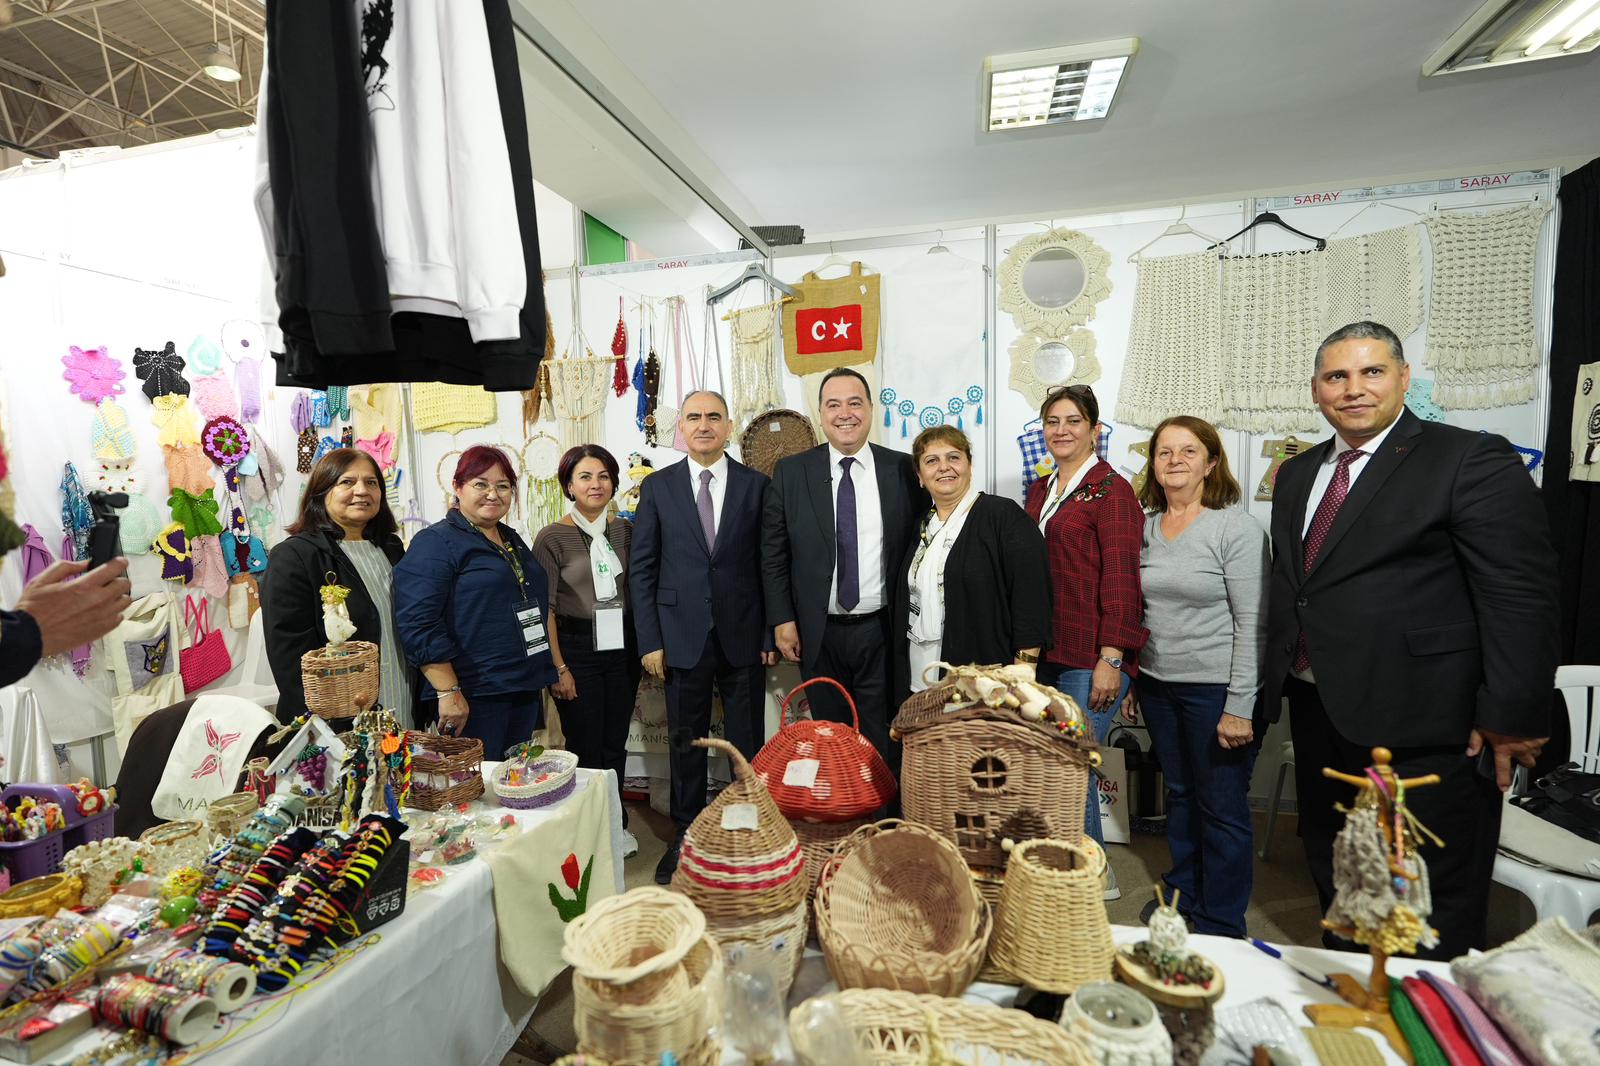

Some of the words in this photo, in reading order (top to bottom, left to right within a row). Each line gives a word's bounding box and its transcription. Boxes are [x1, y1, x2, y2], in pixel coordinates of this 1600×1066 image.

[1460, 174, 1511, 189] SARAY
[1294, 191, 1341, 205] SARAY
[657, 260, 689, 270] SARAY
[629, 733, 670, 744] MANİS
[1096, 779, 1119, 793] İSA
